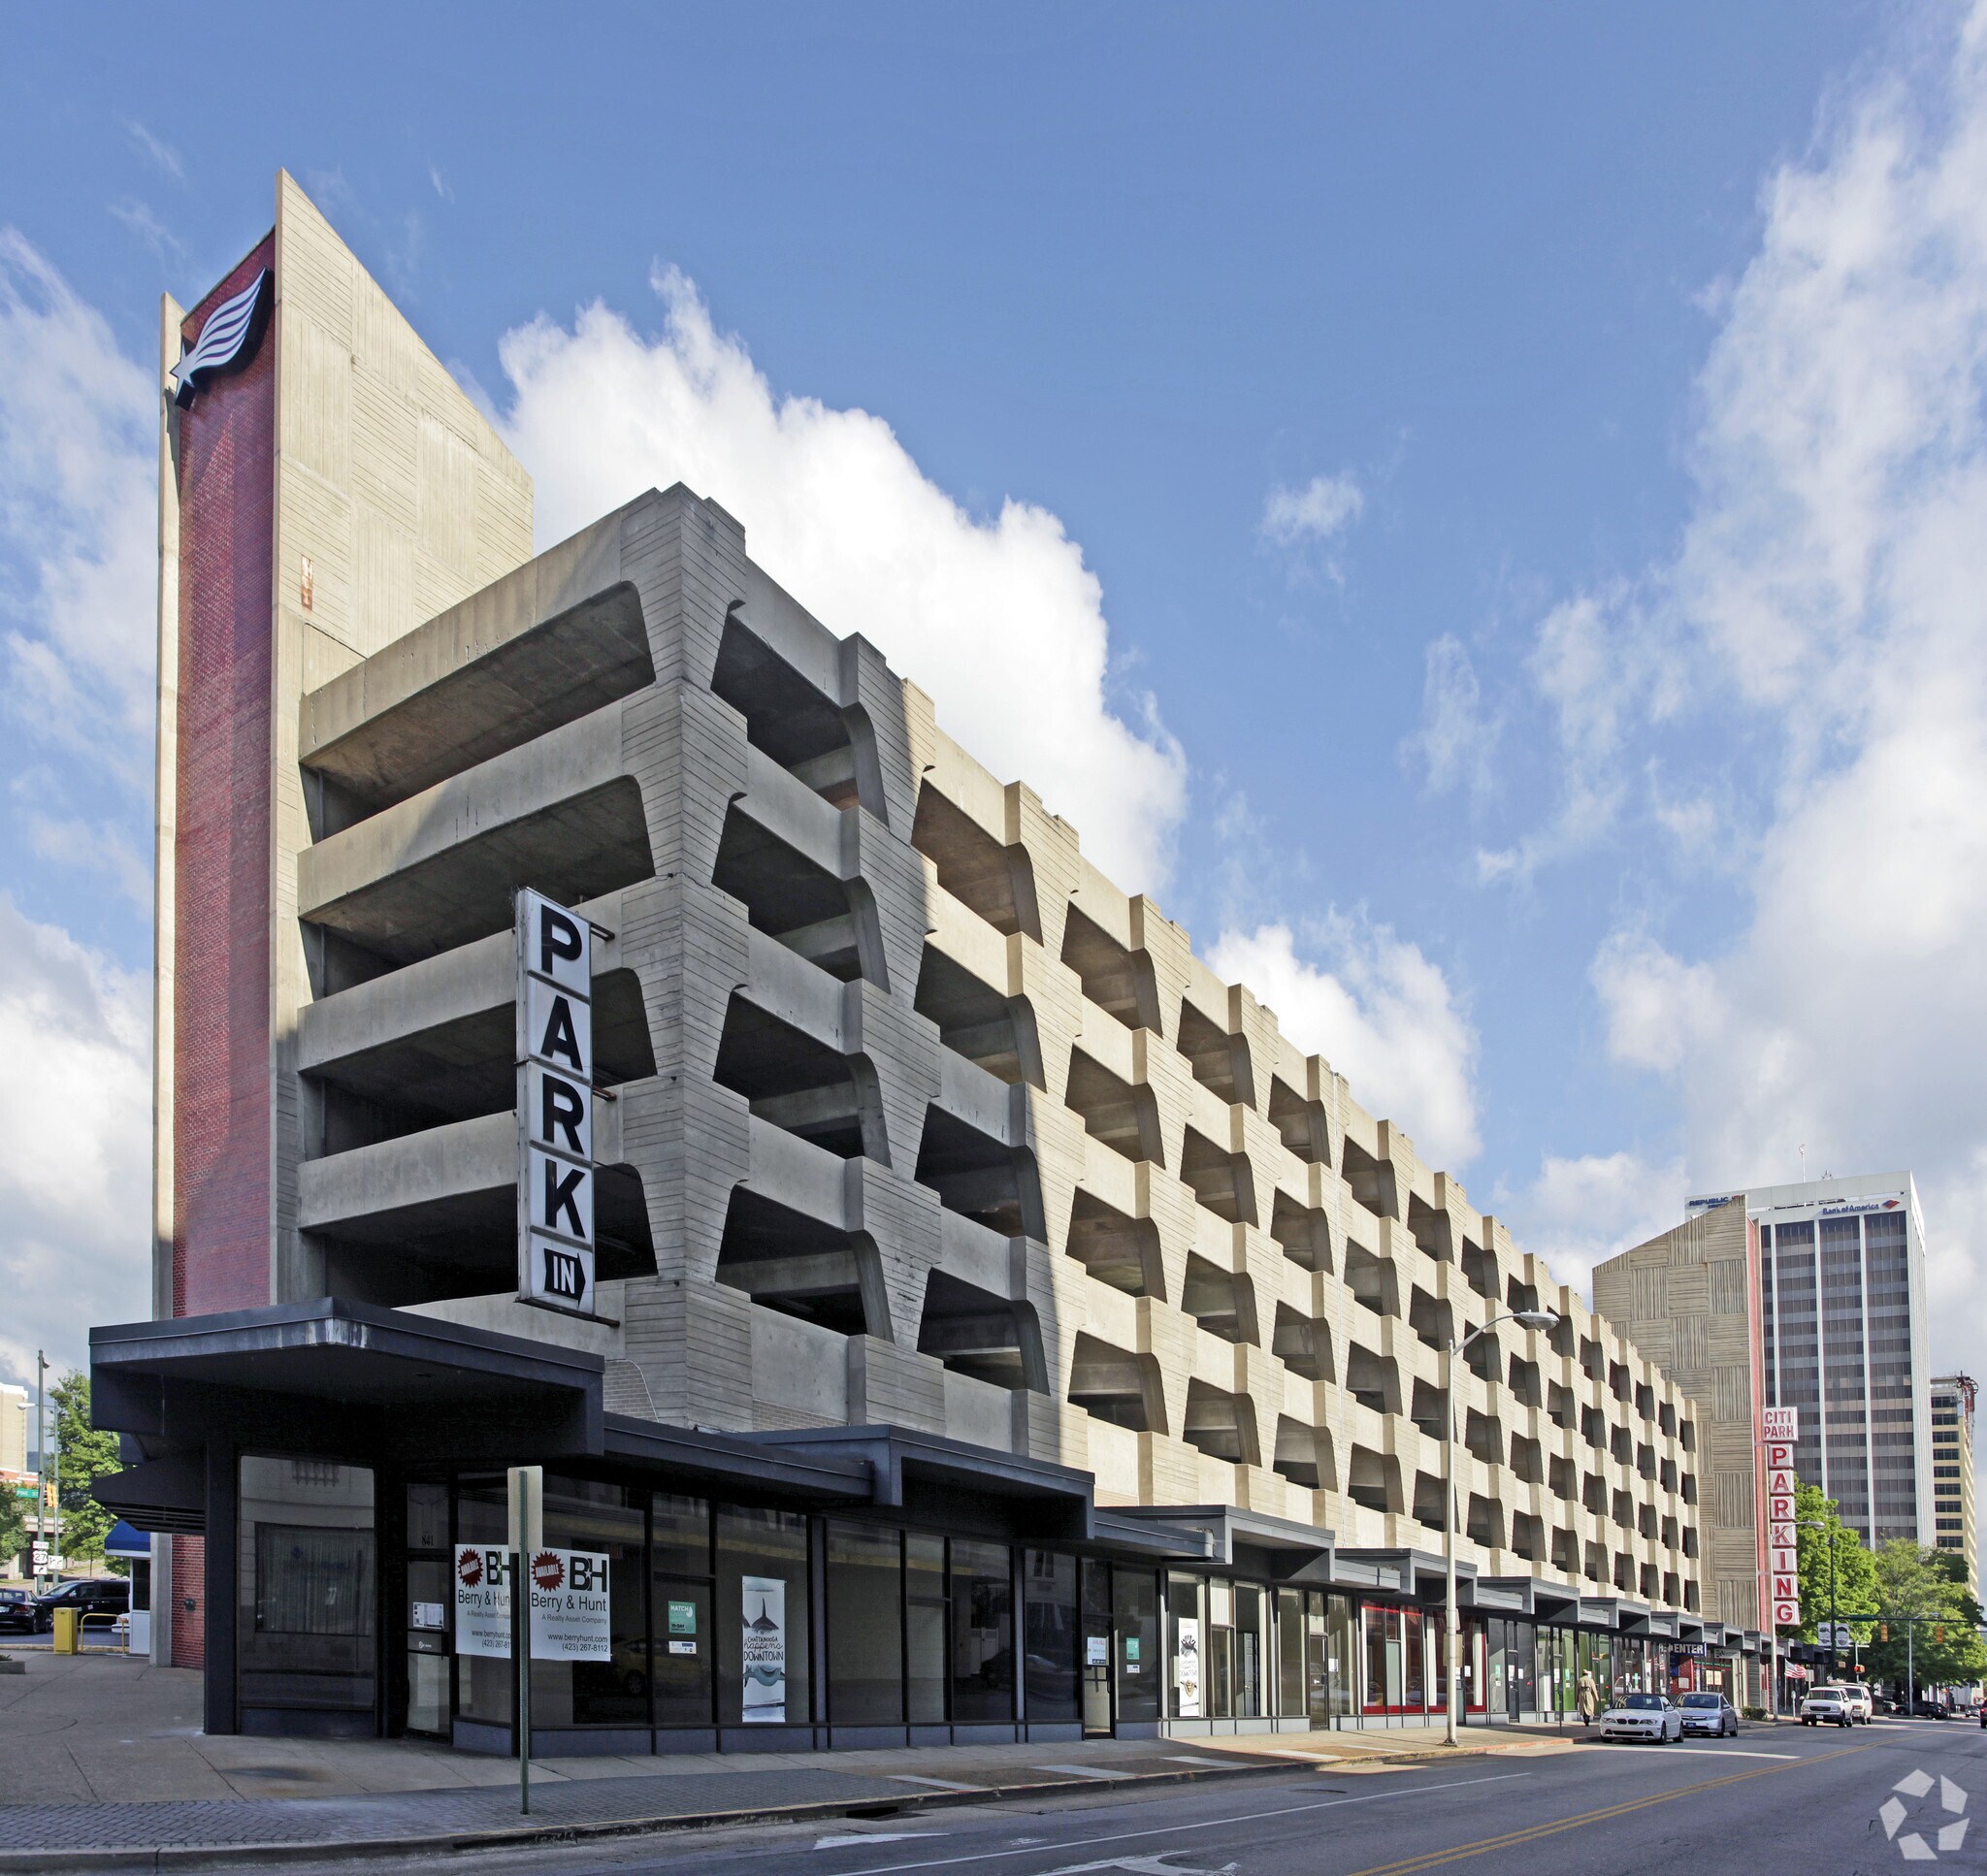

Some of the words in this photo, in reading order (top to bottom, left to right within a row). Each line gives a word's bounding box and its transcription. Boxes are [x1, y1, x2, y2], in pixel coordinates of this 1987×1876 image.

[540, 903, 586, 1239] PARK
[1689, 1196, 1729, 1207] REPUBLIC
[1822, 1206, 1840, 1215] Bank
[1849, 1203, 1879, 1213] America
[553, 1254, 575, 1295] IN
[1765, 1411, 1791, 1423] CITI
[1764, 1425, 1794, 1439] PARK
[1772, 1447, 1794, 1623] PARKING
[35, 1553, 47, 1562] 27
[458, 1589, 482, 1608] Berry
[485, 1591, 491, 1605] &
[494, 1591, 510, 1607] Hun
[532, 1592, 562, 1612] Berry
[567, 1595, 574, 1609] &
[579, 1596, 606, 1612] Hunt
[547, 1614, 565, 1623] Realty
[582, 1616, 607, 1625] Company
[472, 1630, 510, 1639] www.berryhunt.co
[548, 1633, 608, 1643] www.berryhunt.com
[482, 1639, 495, 1649] (423)
[495, 1640, 510, 1649] 267-81
[562, 1643, 578, 1653] (423)
[579, 1643, 608, 1653] 267-8112
[743, 1637, 783, 1652] happens
[743, 1650, 784, 1662] DOWNTOWN
